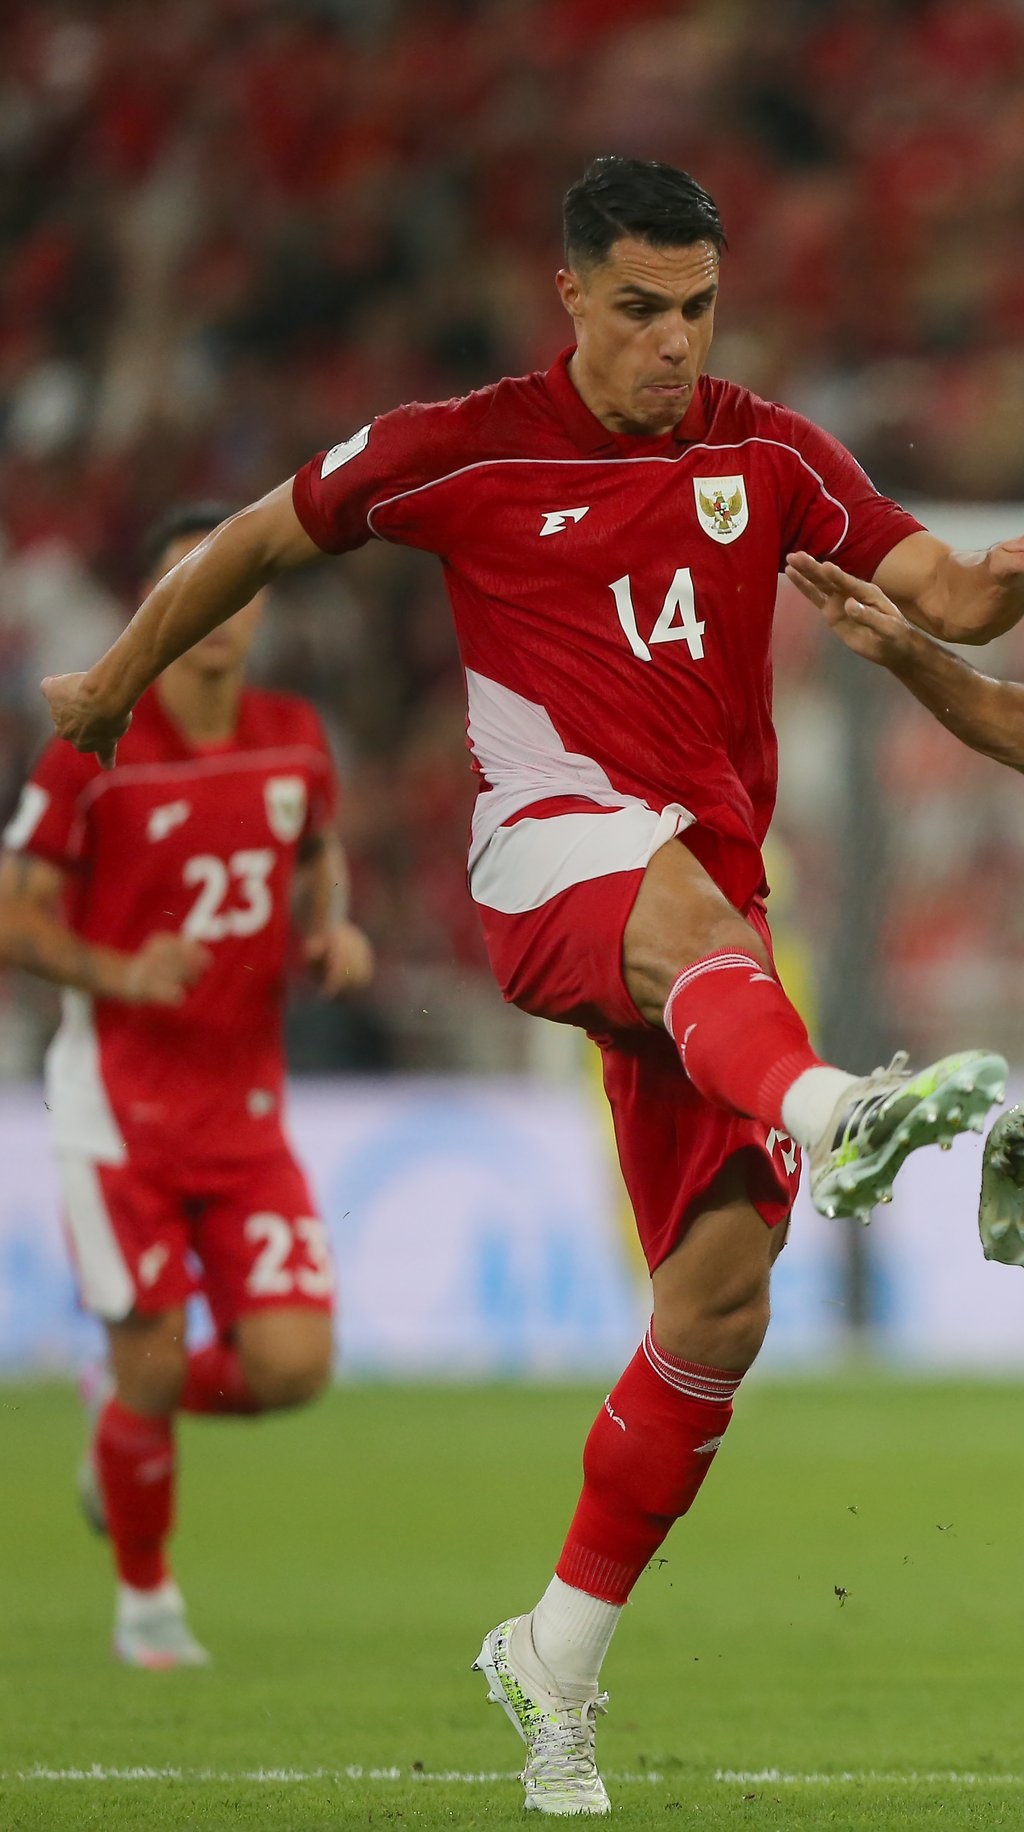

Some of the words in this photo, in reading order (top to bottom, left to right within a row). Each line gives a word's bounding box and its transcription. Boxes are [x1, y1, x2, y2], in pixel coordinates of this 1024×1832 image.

[608, 567, 706, 662] 14
[181, 848, 276, 942] 23
[243, 1210, 334, 1298] 23
